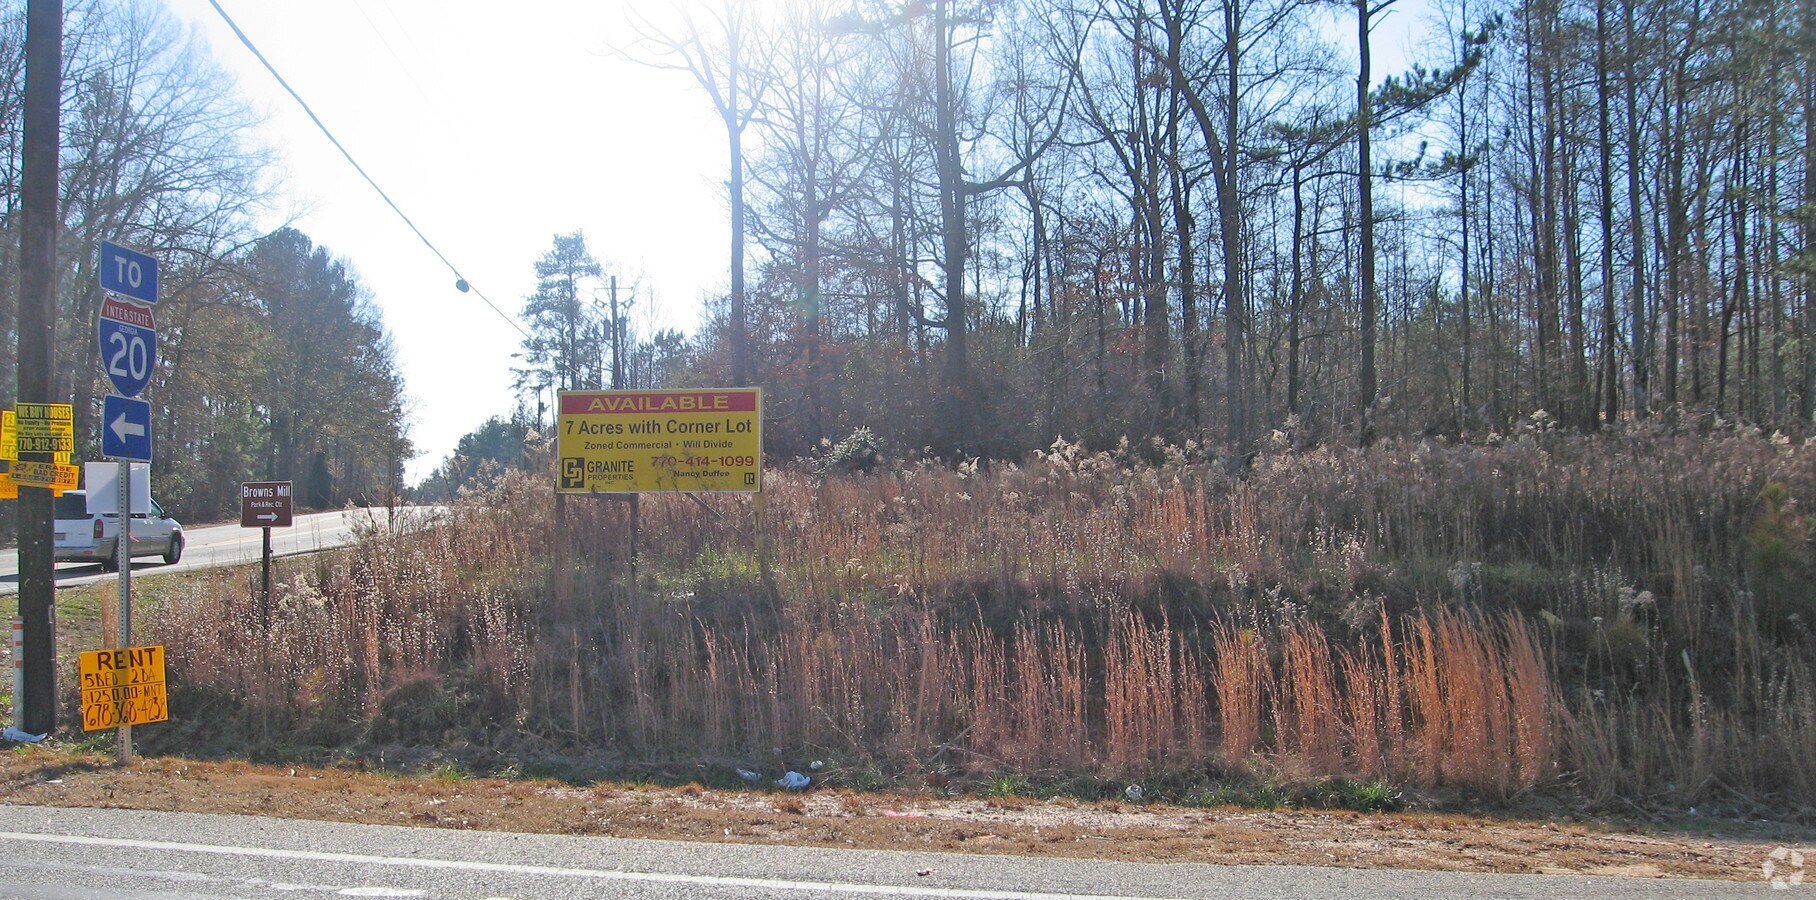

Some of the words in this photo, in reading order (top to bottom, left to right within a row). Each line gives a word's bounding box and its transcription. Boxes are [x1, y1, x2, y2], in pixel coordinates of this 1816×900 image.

[115, 255, 141, 288] TO
[106, 305, 149, 327] INTERSTATE
[119, 325, 138, 335] GEORGIA
[109, 331, 147, 380] 20
[588, 395, 728, 411] AVAILABLE
[17, 405, 29, 418] WE
[30, 406, 43, 418] BUY
[44, 406, 71, 419] HOUSES
[566, 421, 574, 434] 7
[579, 420, 623, 435] Acres
[629, 420, 661, 434] with
[667, 419, 720, 434] Corner
[726, 418, 752, 433] Lot
[18, 437, 72, 451] 770-912-9133
[584, 441, 613, 450] Zoned
[616, 440, 672, 450] Commercial
[683, 440, 700, 448] Will
[703, 440, 733, 448] Divide
[38, 464, 73, 472] ERASE
[587, 460, 634, 473] GRANITE
[651, 455, 754, 467] 770-414-1099
[33, 468, 48, 476] BAD
[50, 470, 75, 479] CREDIT
[673, 470, 700, 478] Nancy
[243, 486, 274, 498] Browns
[277, 485, 291, 497] Mill
[97, 648, 155, 670] RENT
[86, 698, 166, 726] 678-368-4238
